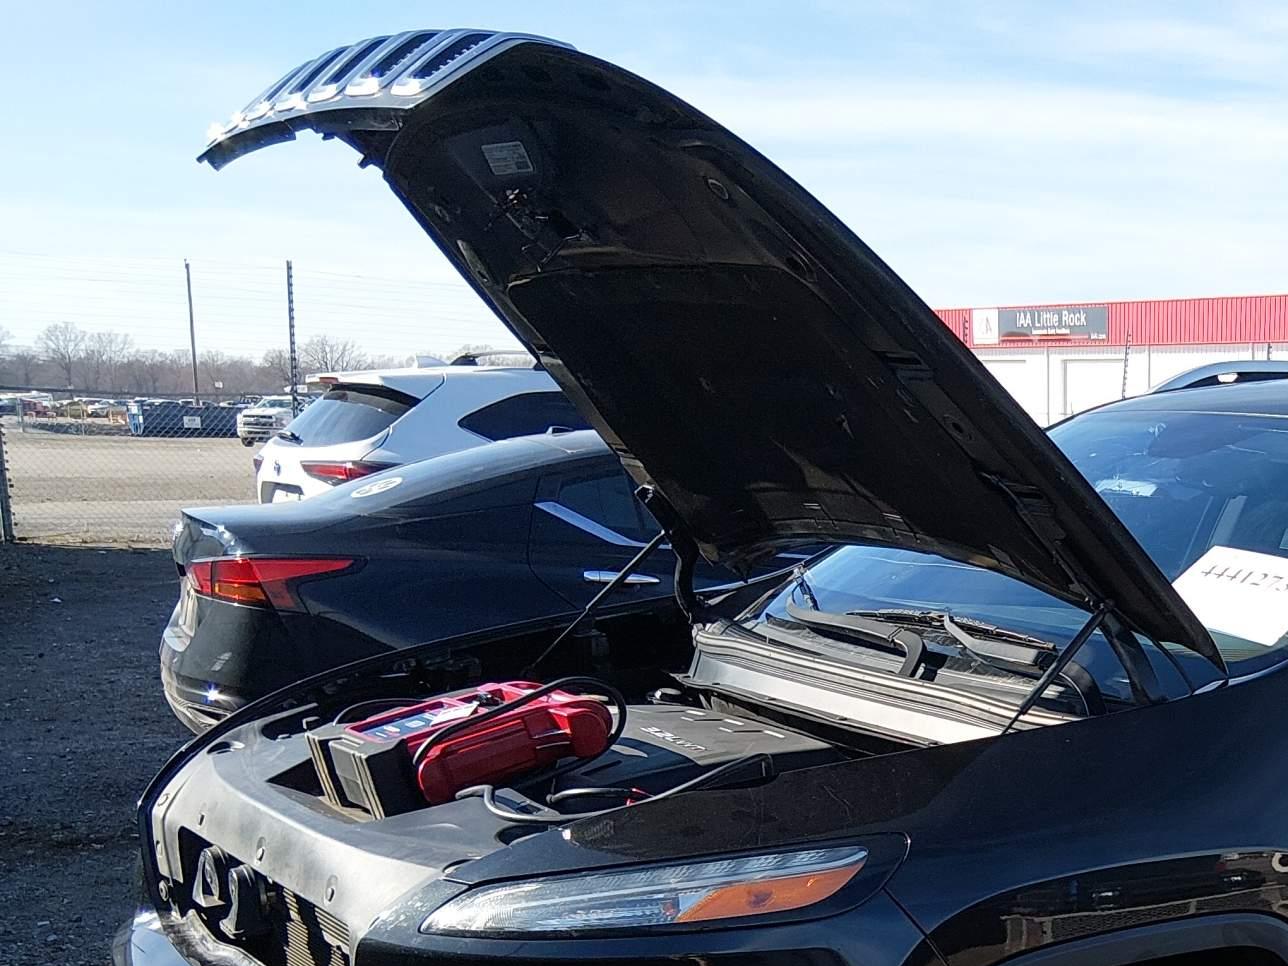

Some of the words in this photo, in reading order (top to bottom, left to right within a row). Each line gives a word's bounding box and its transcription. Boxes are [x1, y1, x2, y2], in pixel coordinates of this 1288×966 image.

[1016, 312, 1032, 327] IAA
[1035, 310, 1059, 327] Little
[1062, 309, 1087, 326] Rock
